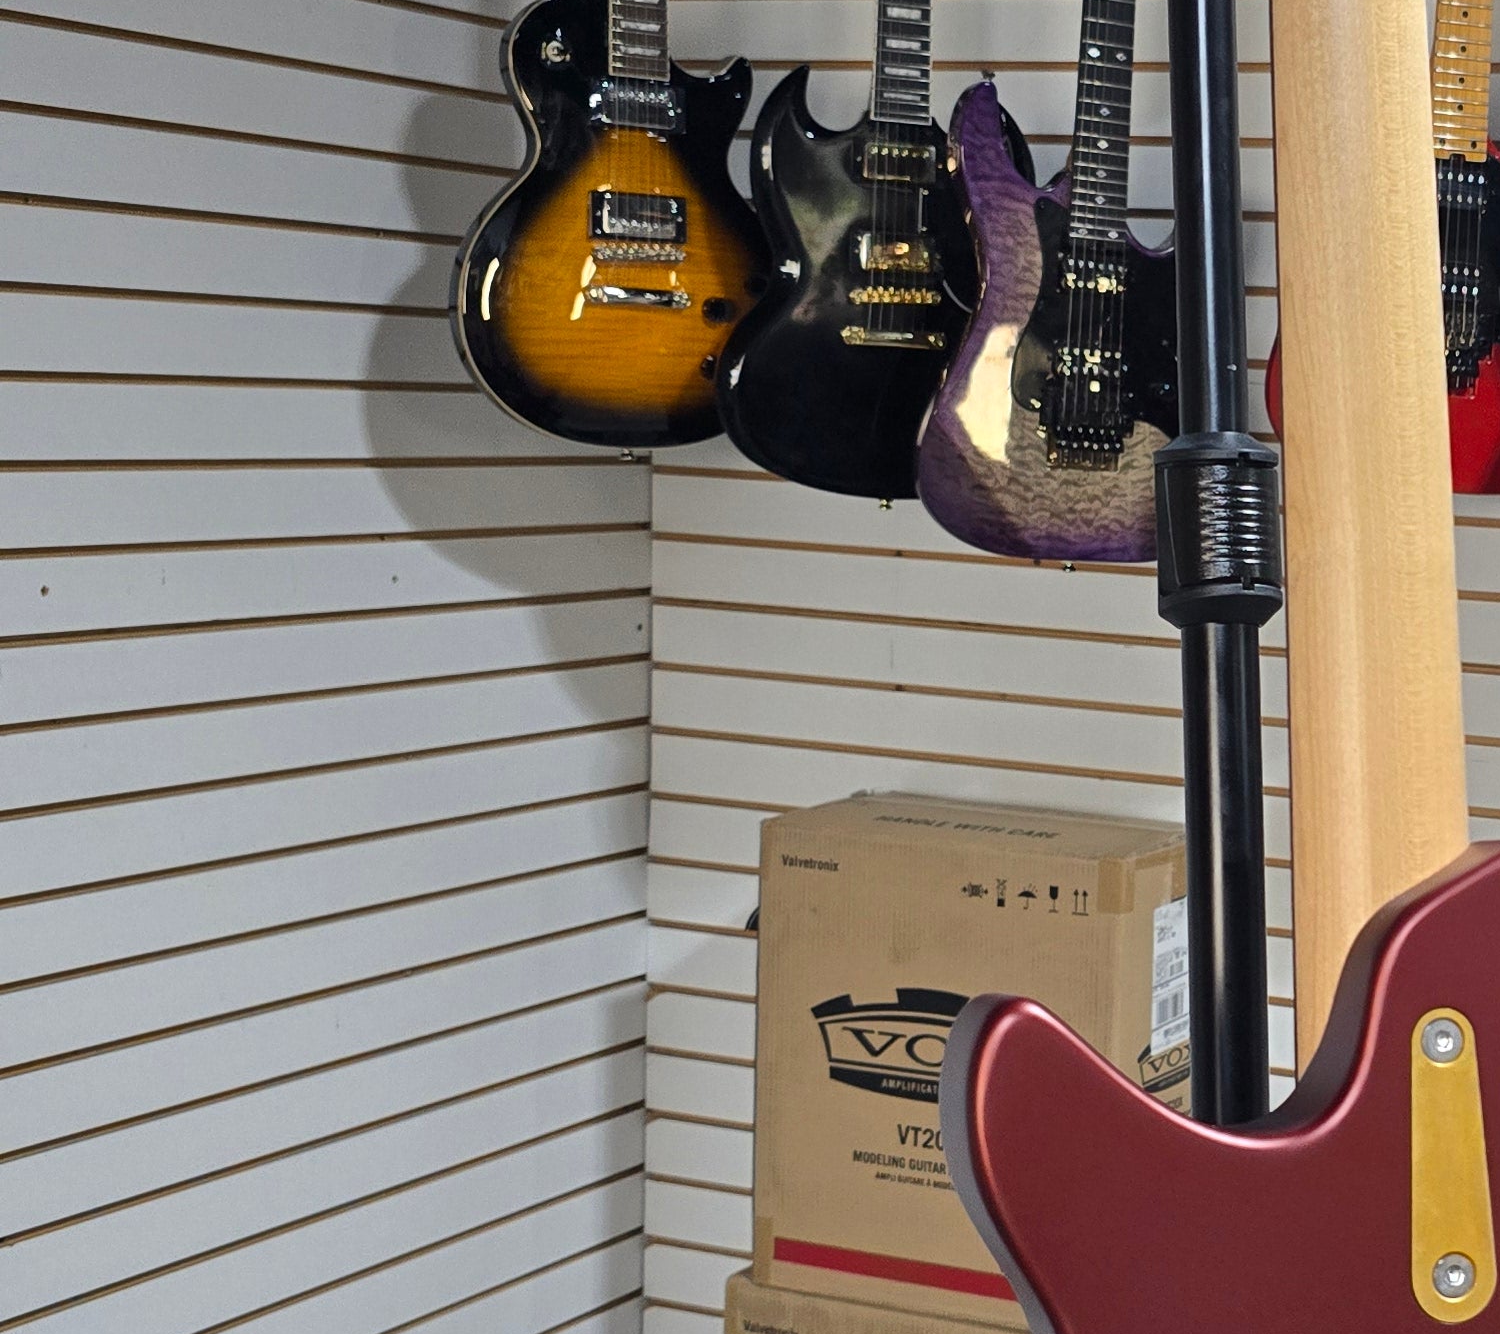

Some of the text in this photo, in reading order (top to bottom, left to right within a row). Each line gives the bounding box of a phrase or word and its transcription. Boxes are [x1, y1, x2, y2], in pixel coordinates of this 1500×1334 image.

[953, 823, 1006, 833] WITH
[1008, 828, 1060, 839] CARE
[781, 854, 840, 872] Valvetronix
[853, 1149, 947, 1175] MODELING GUITAR
